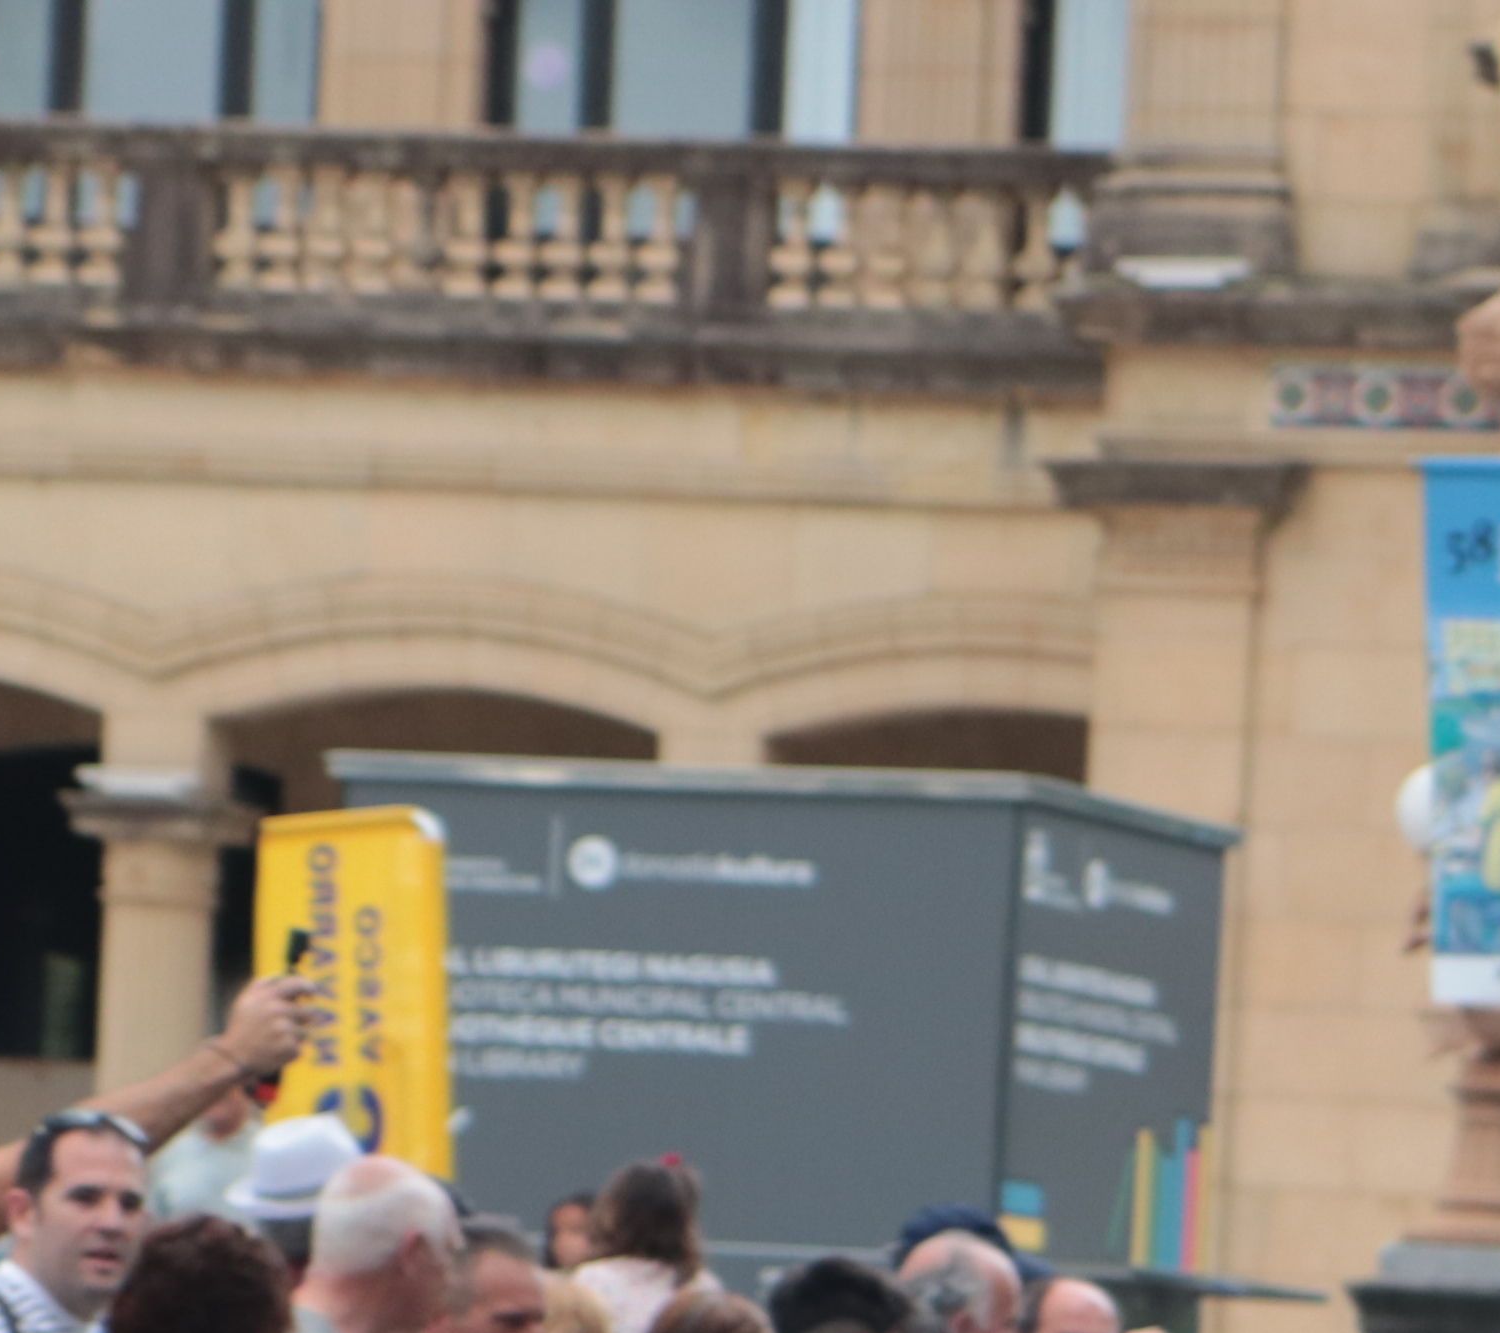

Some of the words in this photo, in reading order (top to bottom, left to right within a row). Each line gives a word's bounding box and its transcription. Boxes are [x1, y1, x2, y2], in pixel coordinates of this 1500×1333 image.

[1448, 518, 1496, 576] 58
[715, 989, 848, 1027] CENTRAL
[598, 1016, 753, 1057] CENTRALE
